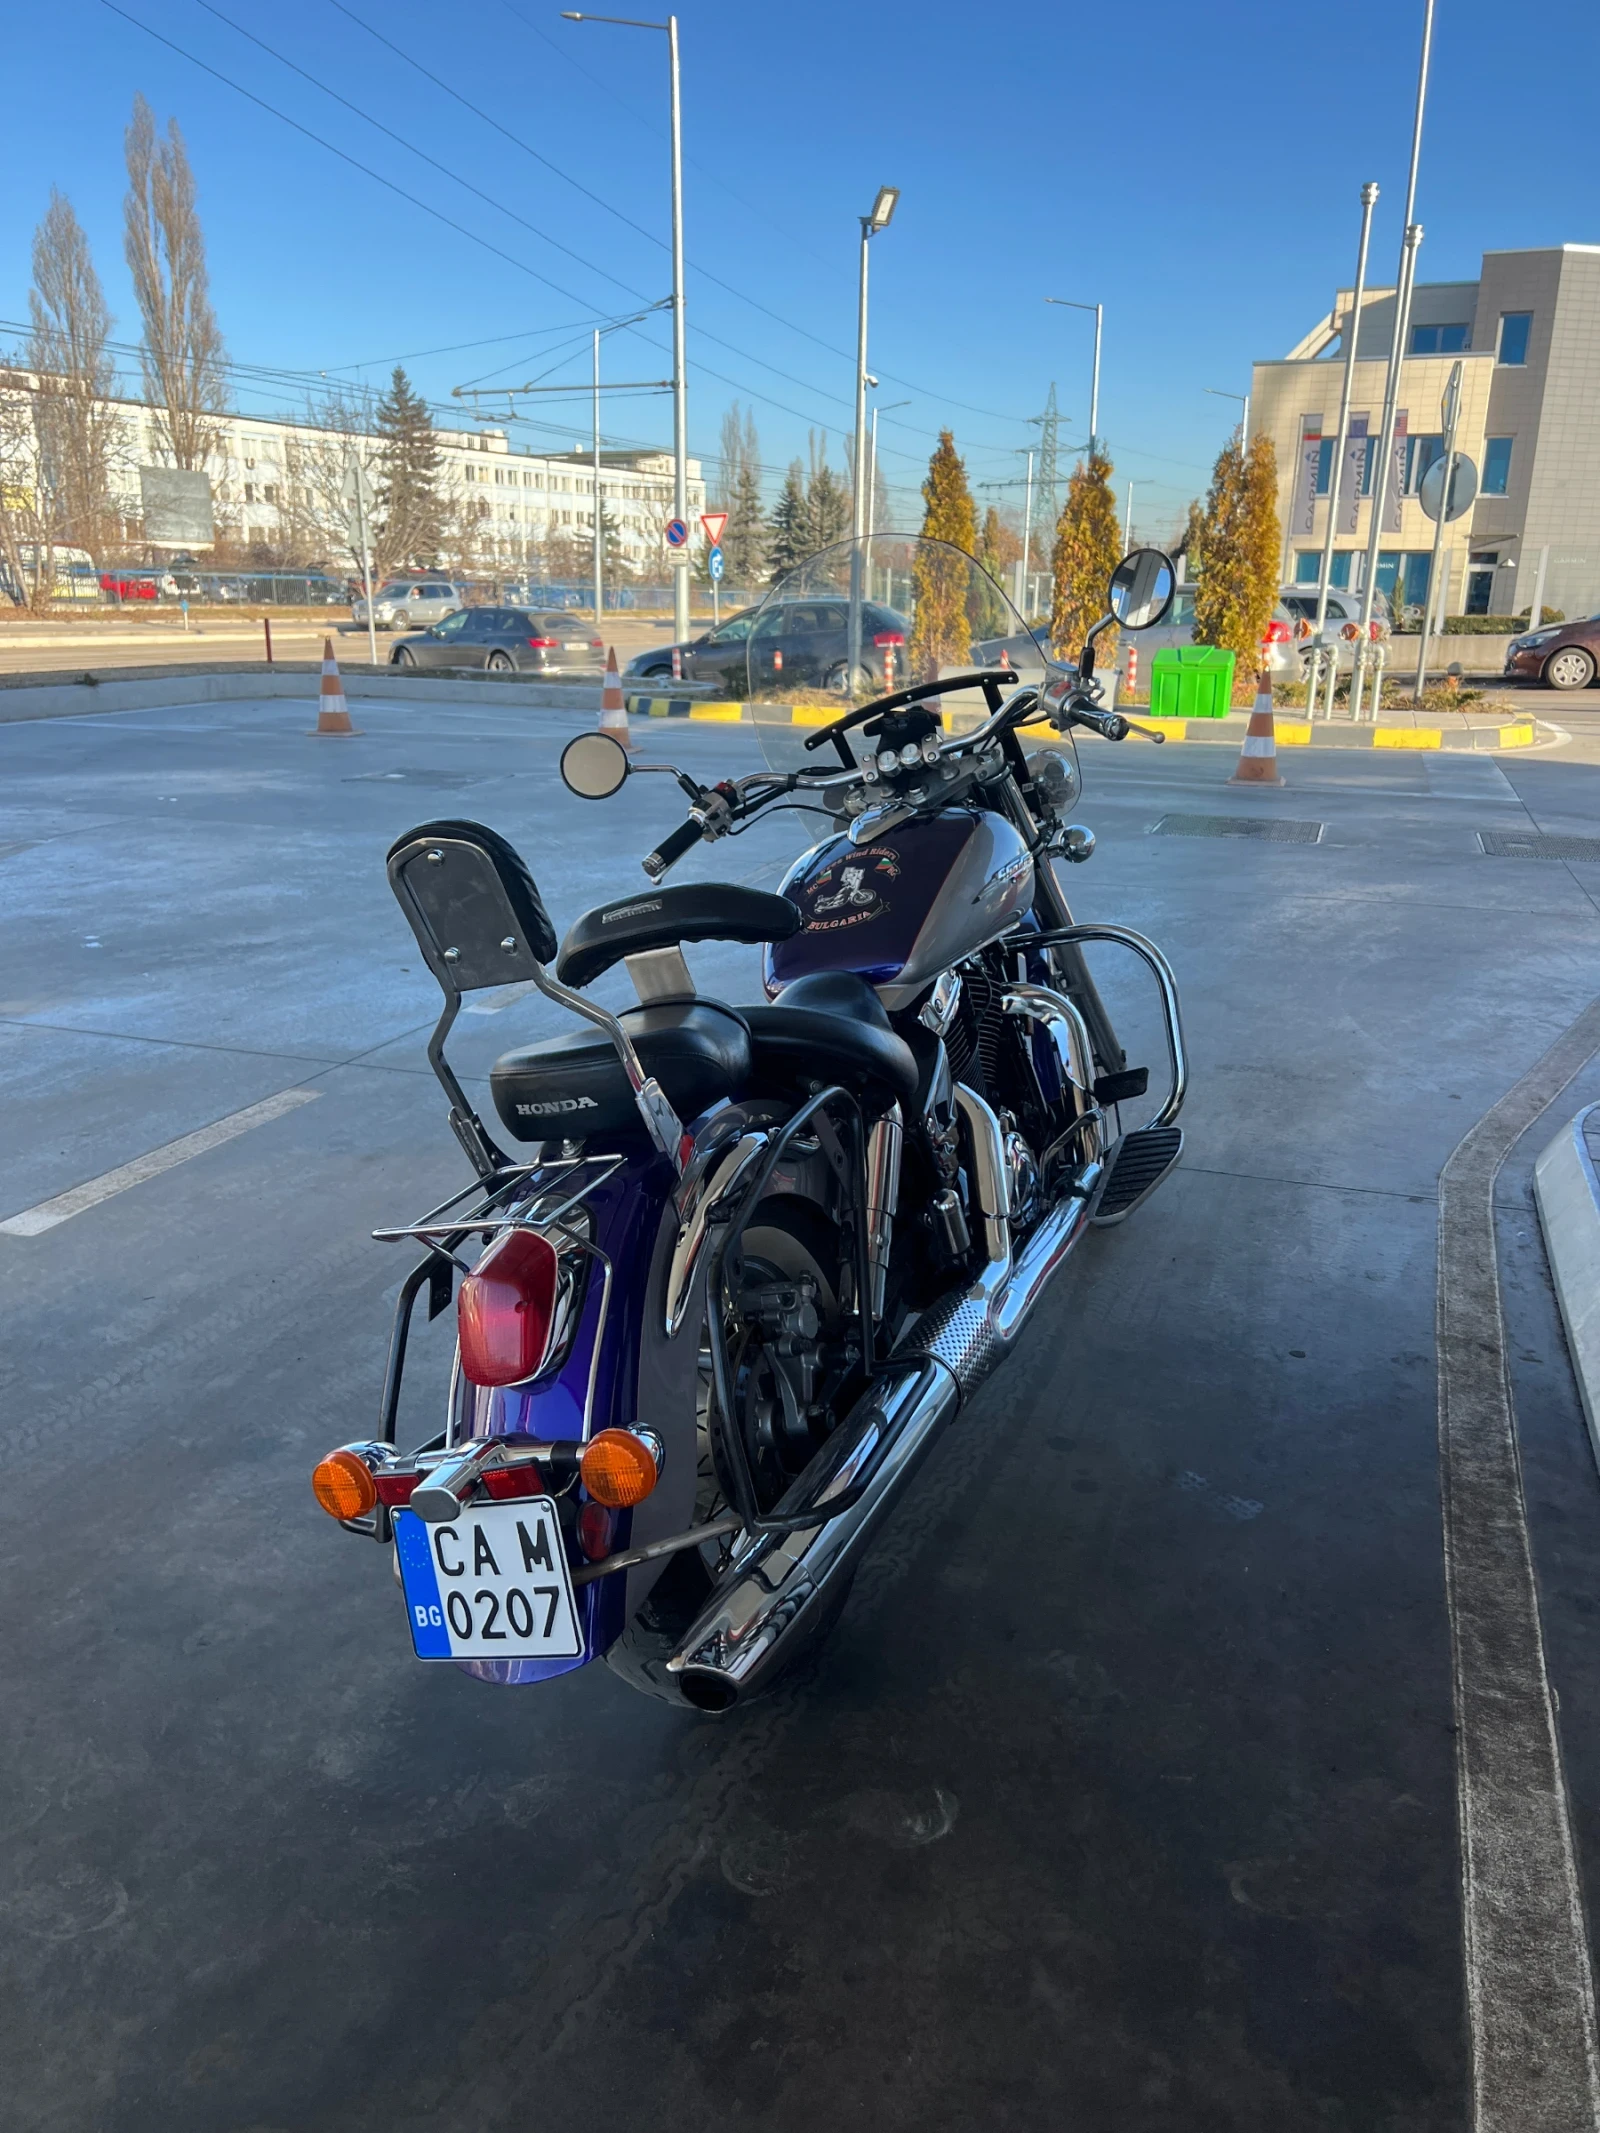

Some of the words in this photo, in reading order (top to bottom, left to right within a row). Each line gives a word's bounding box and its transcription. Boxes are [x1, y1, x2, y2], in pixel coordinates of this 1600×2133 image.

[1305, 450, 1320, 529] GARMIN
[1350, 448, 1366, 529] GARMIN
[845, 848, 869, 860] Wind
[869, 847, 897, 861] Riders
[807, 911, 872, 930] BULGARIA
[516, 1096, 598, 1115] HONDA
[414, 1605, 442, 1628] BG
[446, 1585, 560, 1640] 0207
